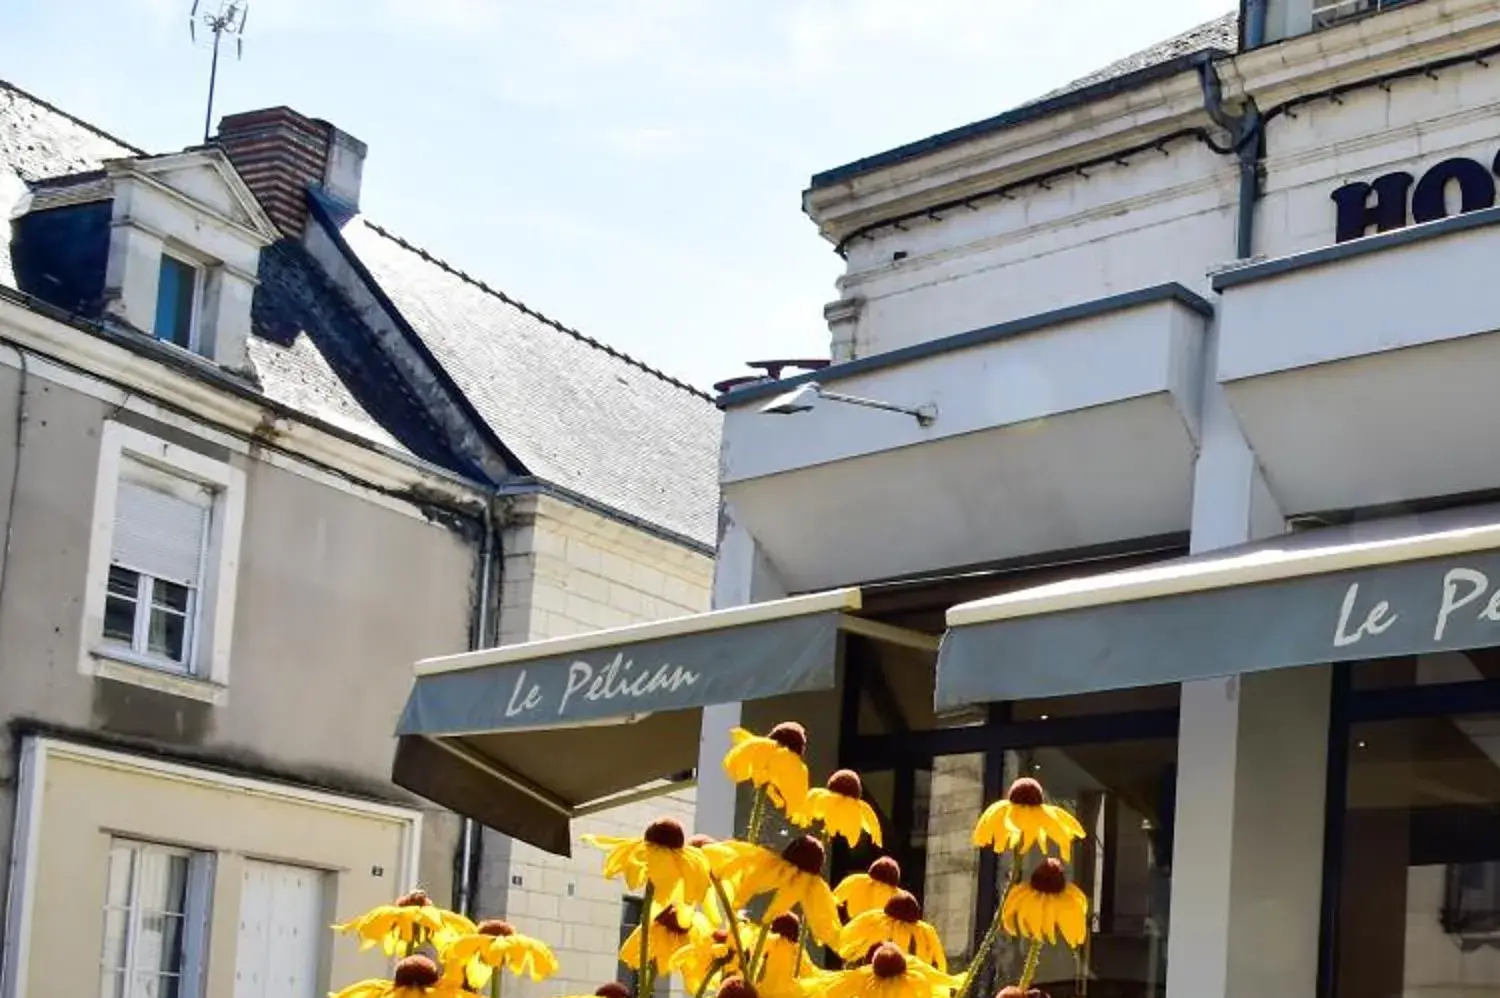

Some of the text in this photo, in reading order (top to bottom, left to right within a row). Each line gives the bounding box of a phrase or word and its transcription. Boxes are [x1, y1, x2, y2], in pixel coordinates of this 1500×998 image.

[1333, 583, 1398, 647] Le
[505, 652, 700, 716] Le Pélican
